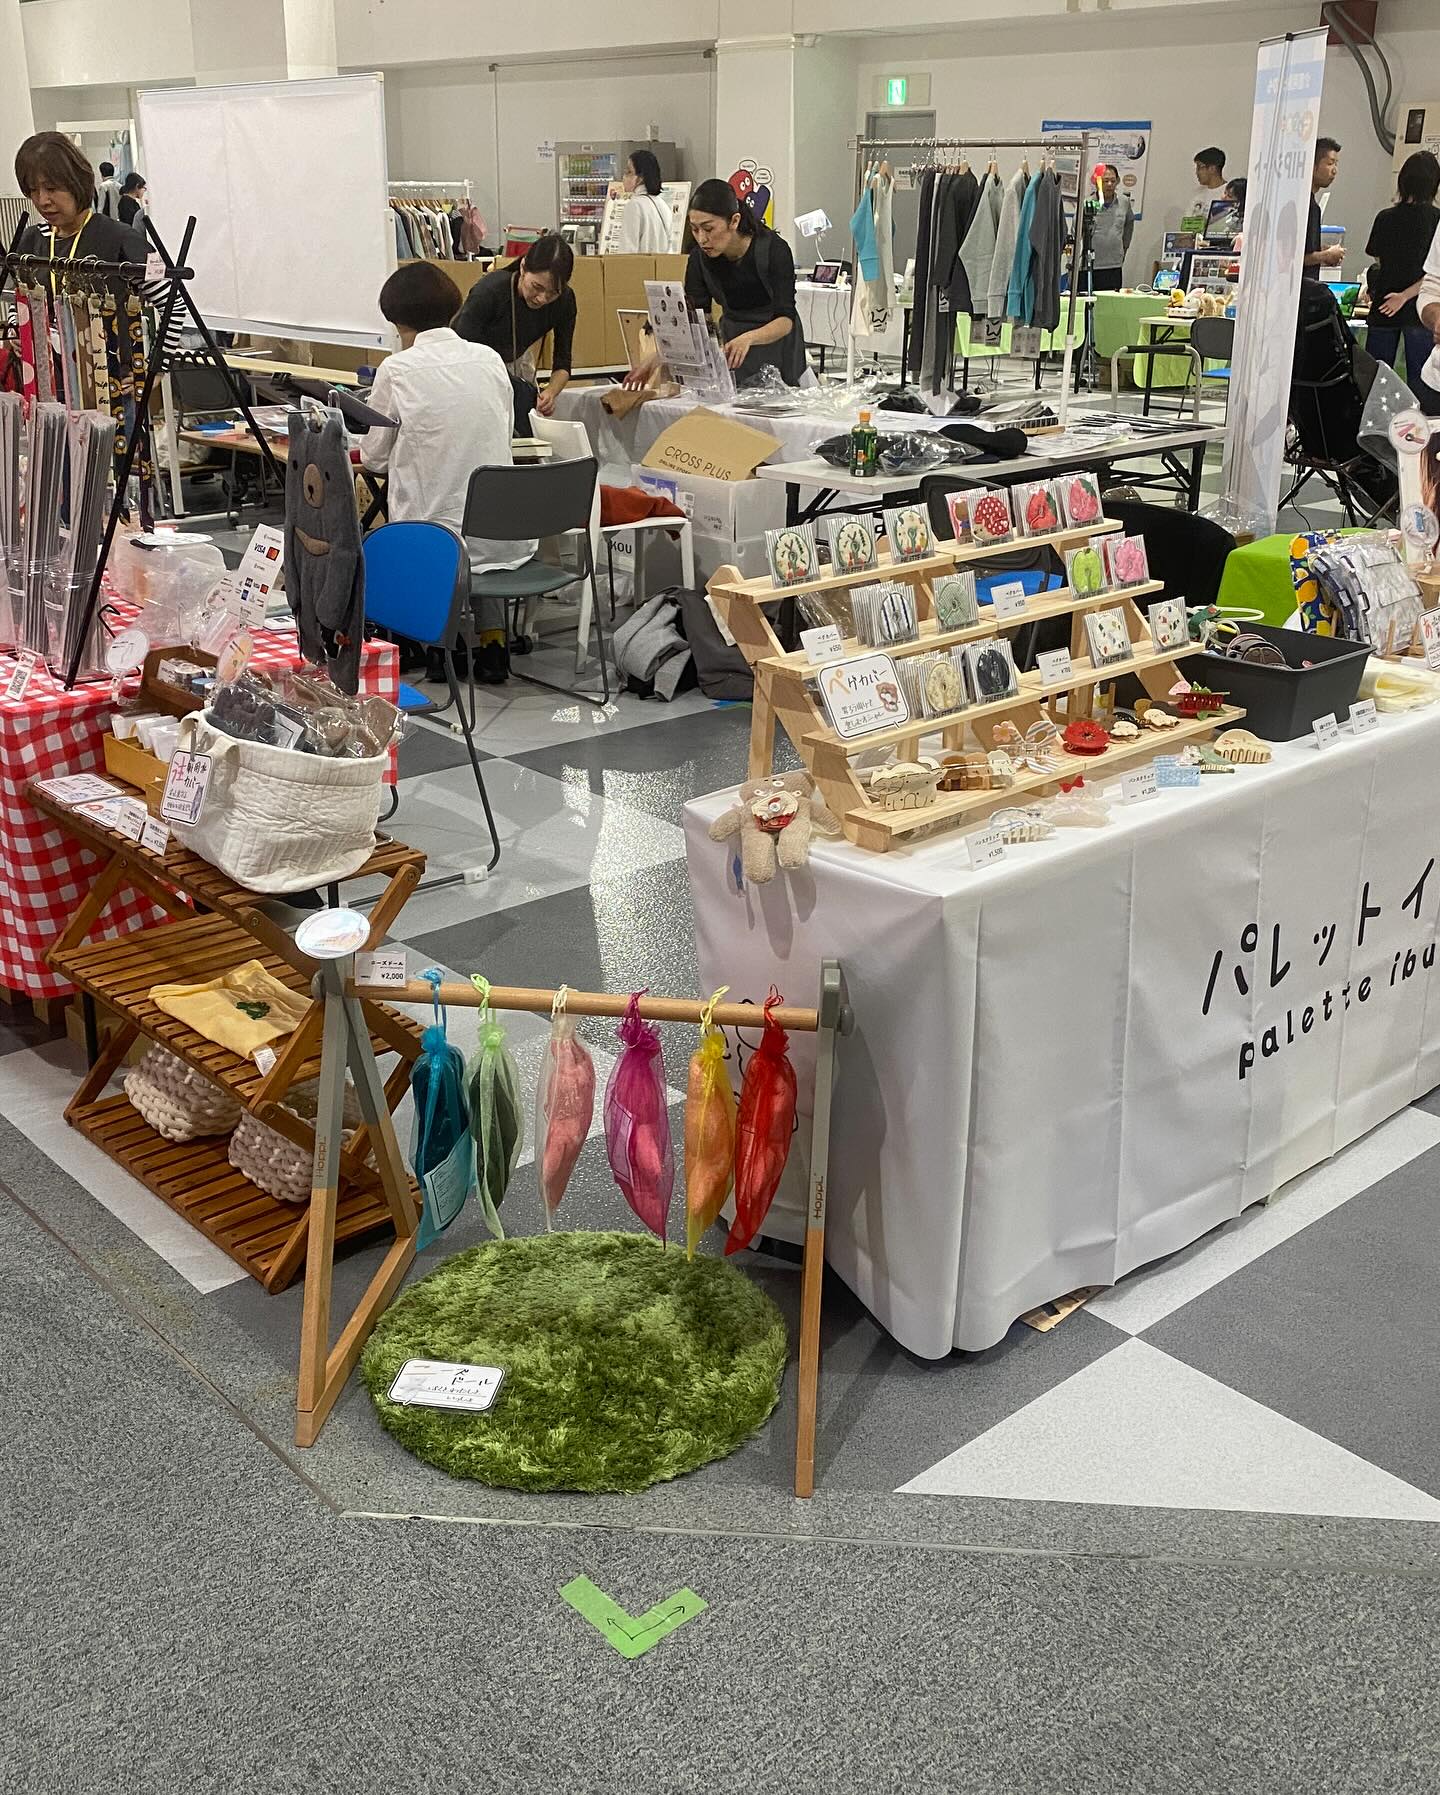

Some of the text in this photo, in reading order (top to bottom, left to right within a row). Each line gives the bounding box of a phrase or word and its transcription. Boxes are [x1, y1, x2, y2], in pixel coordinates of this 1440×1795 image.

[664, 446, 731, 480] CROSS PLUS
[254, 543, 266, 555] VISA
[1201, 858, 1435, 1015] パレットイ
[381, 972, 404, 980] ¥2,000
[1238, 942, 1436, 1081] palette ibu
